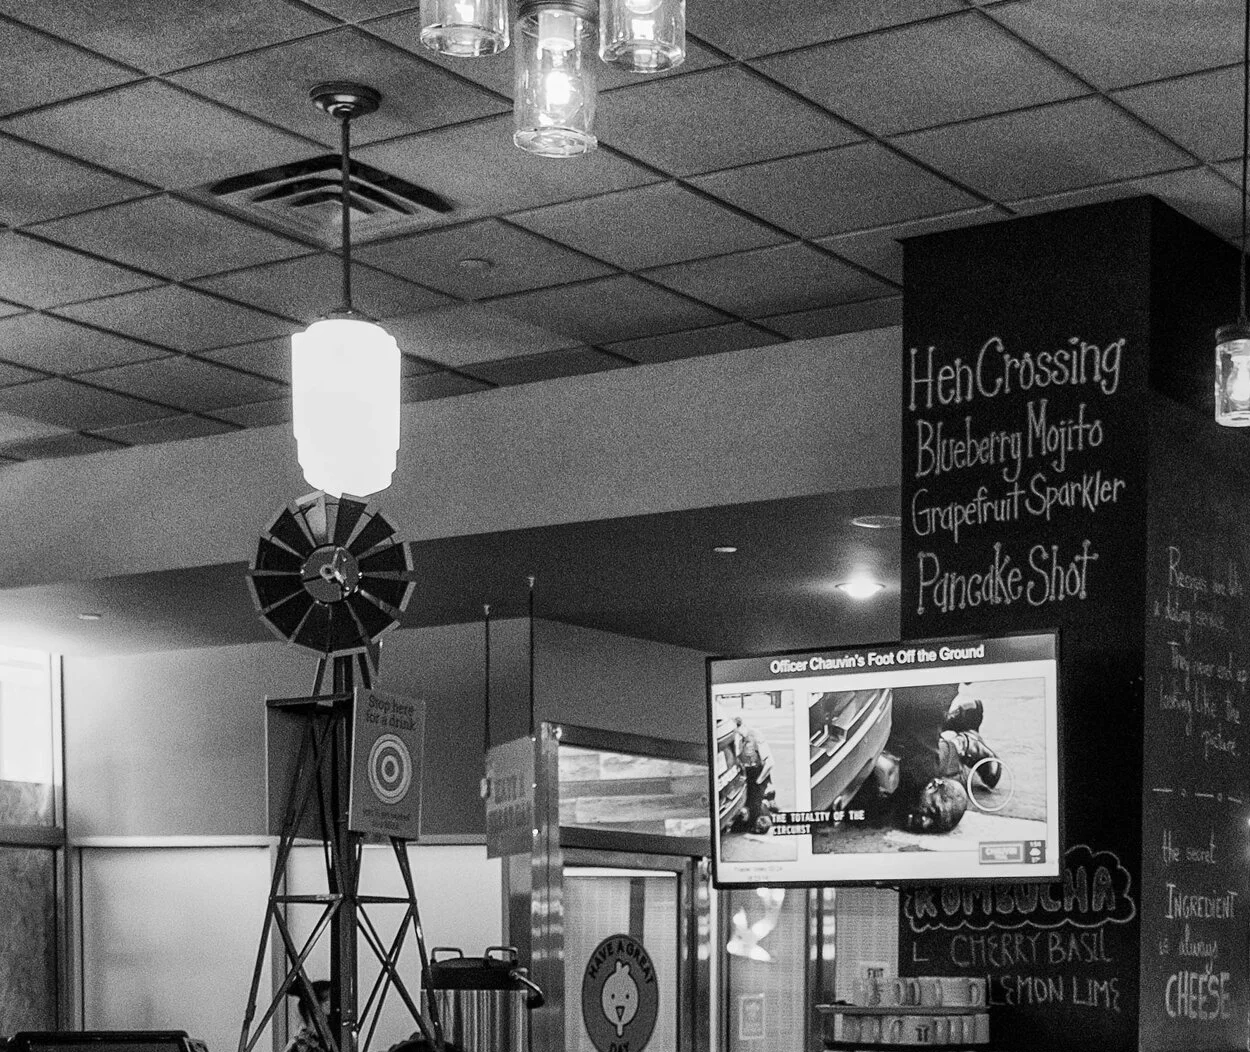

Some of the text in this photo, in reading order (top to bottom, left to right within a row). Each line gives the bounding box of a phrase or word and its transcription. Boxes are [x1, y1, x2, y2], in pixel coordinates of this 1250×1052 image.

[915, 399, 1103, 482] Blueberry Mojito
[912, 470, 1126, 543] Grapefruit Sparkler
[917, 539, 1100, 615] Pancake Shot
[769, 644, 985, 675] Officer Chauvin's Foot Off the Ground
[366, 710, 380, 724] for
[389, 715, 416, 731] drink
[368, 694, 414, 716] Stop here
[771, 809, 865, 823] THE TOTALITY OF THE
[1161, 830, 1180, 866] the
[1165, 883, 1238, 919] INGREDIENT
[588, 941, 654, 984] HAVE A GREAT
[951, 932, 1042, 967] CHERRY
[1050, 928, 1113, 964] BASIL
[986, 974, 1121, 1013] LEMON LIME
[1165, 970, 1230, 1019] CHEESE
